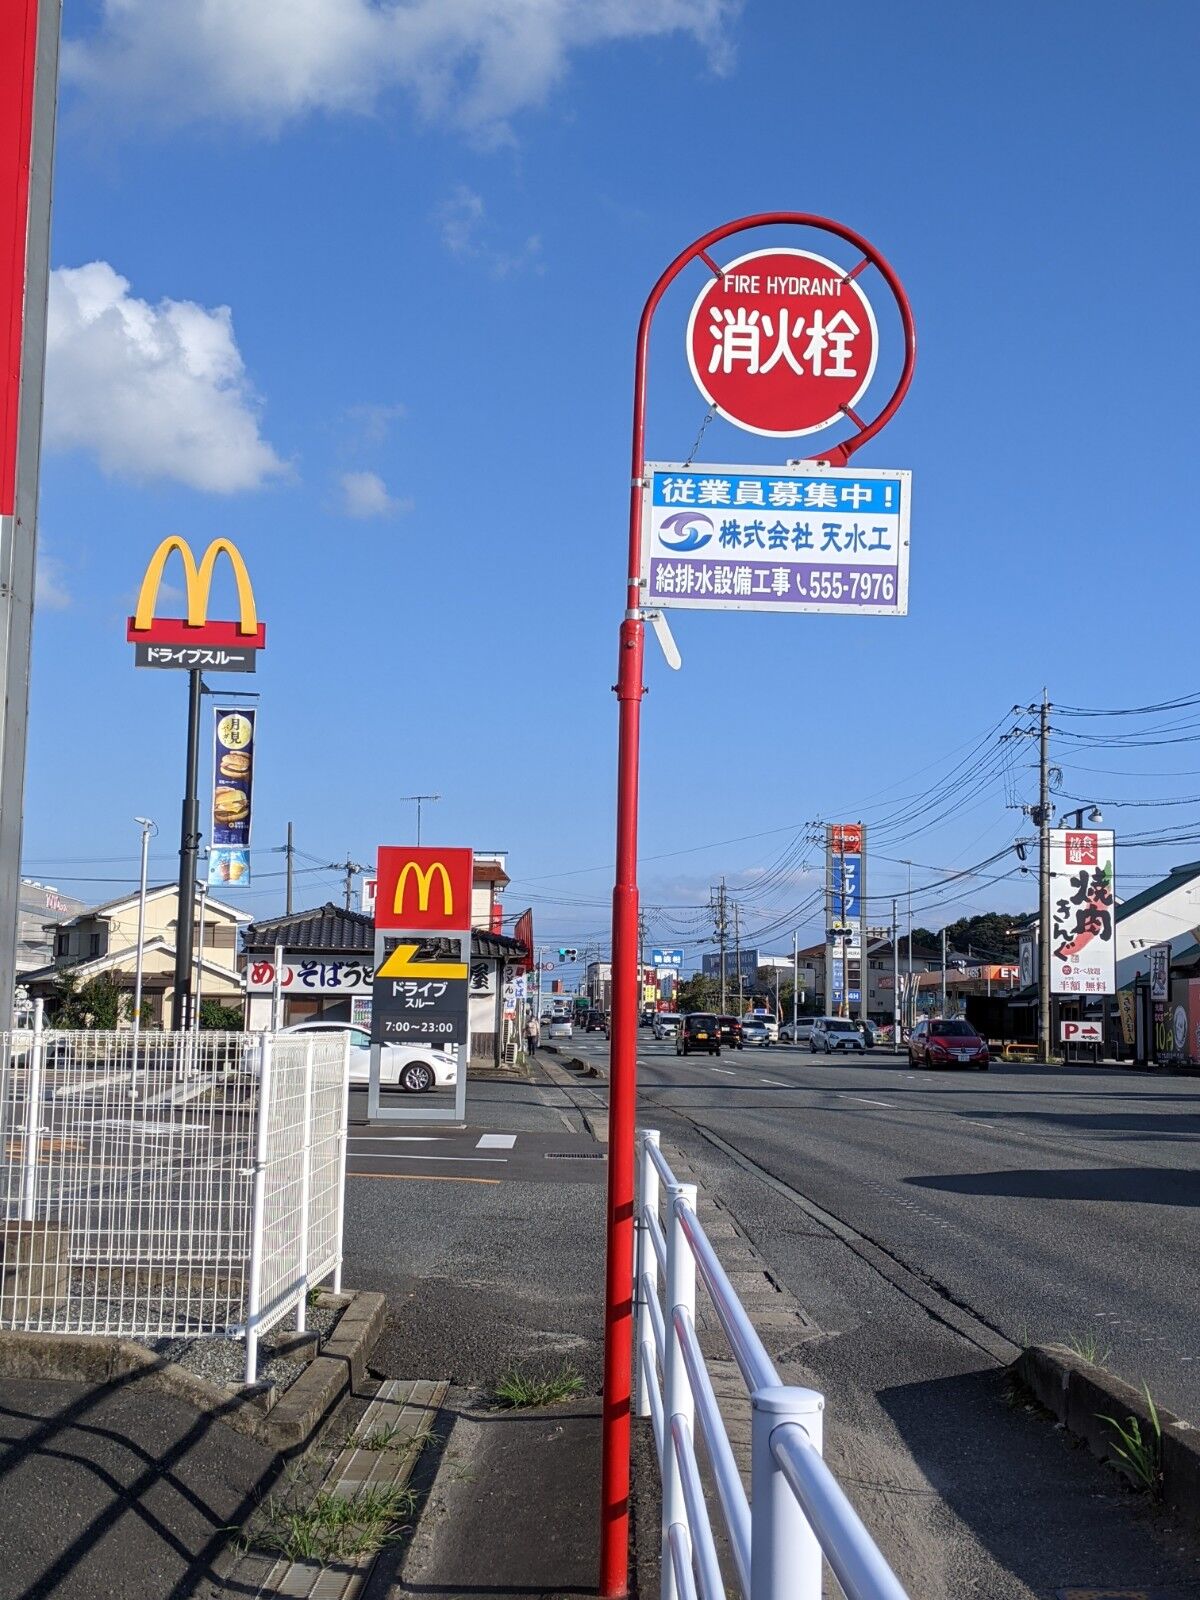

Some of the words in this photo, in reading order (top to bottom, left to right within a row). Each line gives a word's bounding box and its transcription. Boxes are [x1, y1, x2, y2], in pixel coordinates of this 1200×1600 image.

[723, 274, 761, 294] FIRE
[766, 276, 844, 297] HYDRANT
[708, 306, 861, 378] 消火栓
[661, 477, 894, 509] 従業員募集中！
[718, 518, 815, 551] 株式会社
[820, 521, 892, 553] 天水工
[655, 562, 792, 597] 給排水設備工事
[809, 571, 895, 601] 555-7976
[147, 647, 246, 665] ドライブスルー
[230, 718, 242, 744] 月見
[1070, 866, 1113, 942] 焼肉
[1053, 898, 1075, 962] きんぐ
[392, 981, 449, 998] ドライブ
[404, 998, 435, 1009] スルー
[385, 1021, 453, 1033] 7:00～23:00
[1064, 1023, 1079, 1040] P
